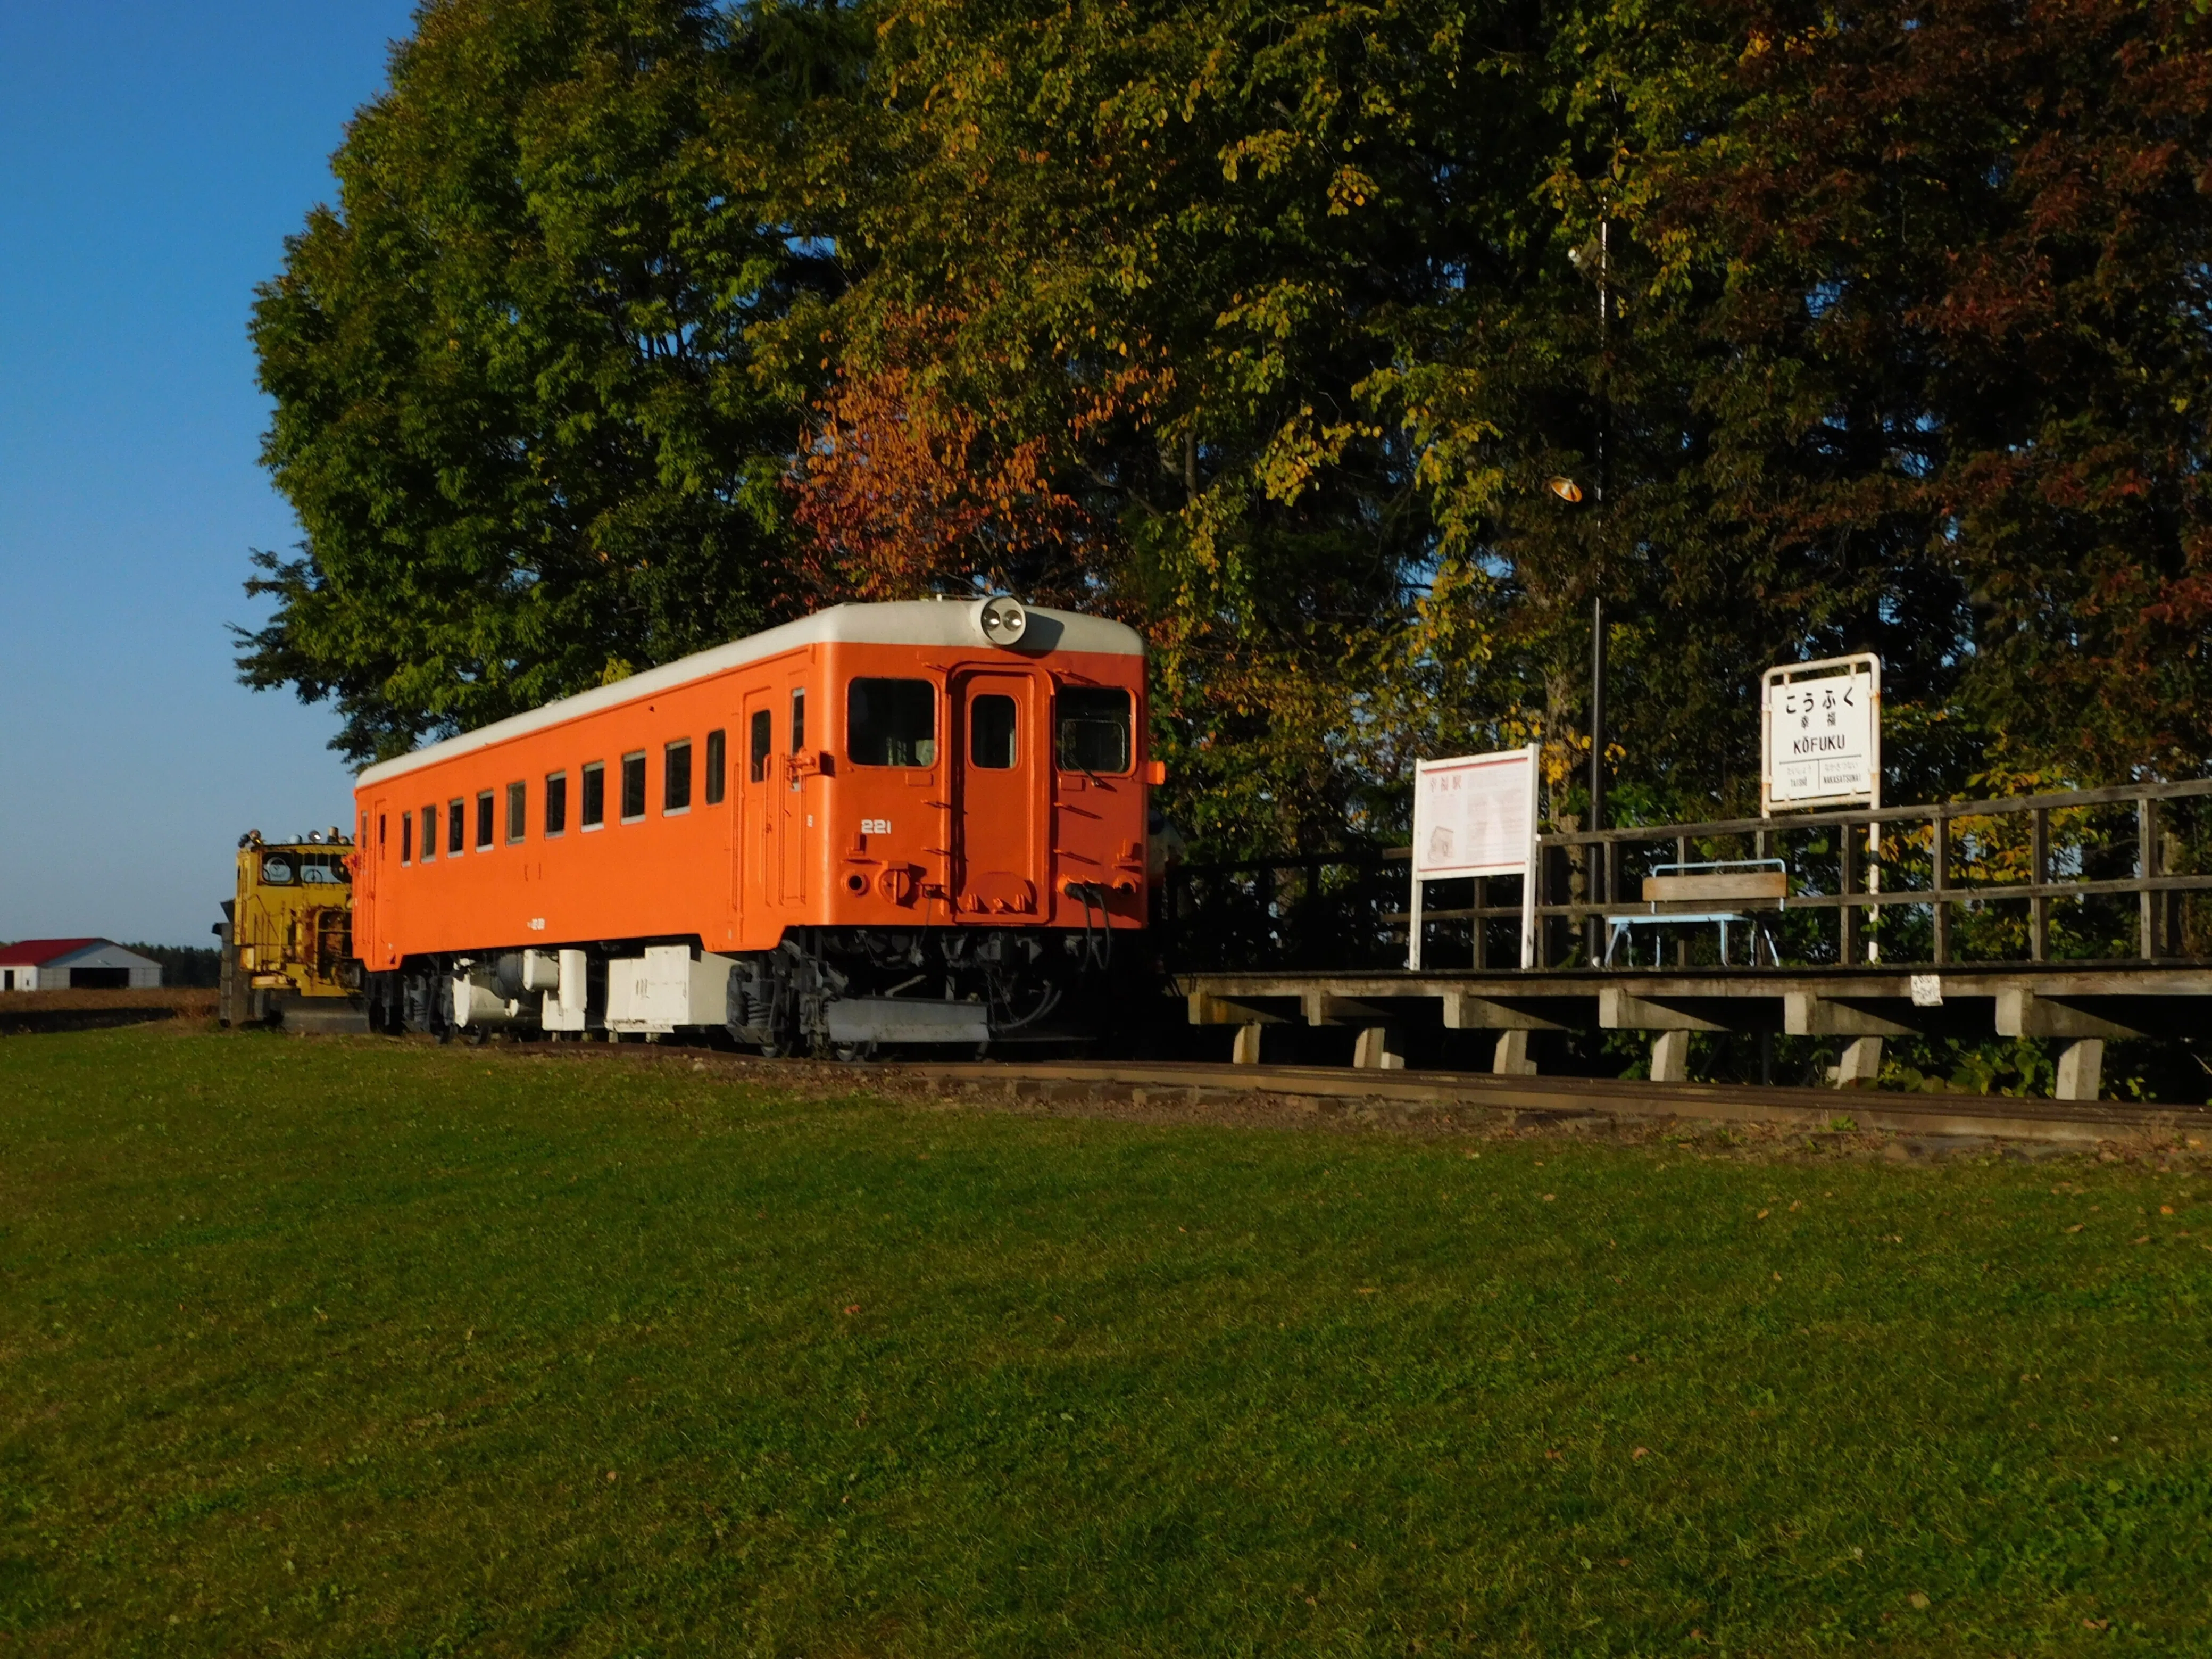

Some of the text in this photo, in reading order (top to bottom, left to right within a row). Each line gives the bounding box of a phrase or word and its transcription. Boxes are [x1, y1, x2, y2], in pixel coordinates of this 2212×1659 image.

[1786, 686, 1853, 714] こうふく
[860, 819, 892, 834] 221
